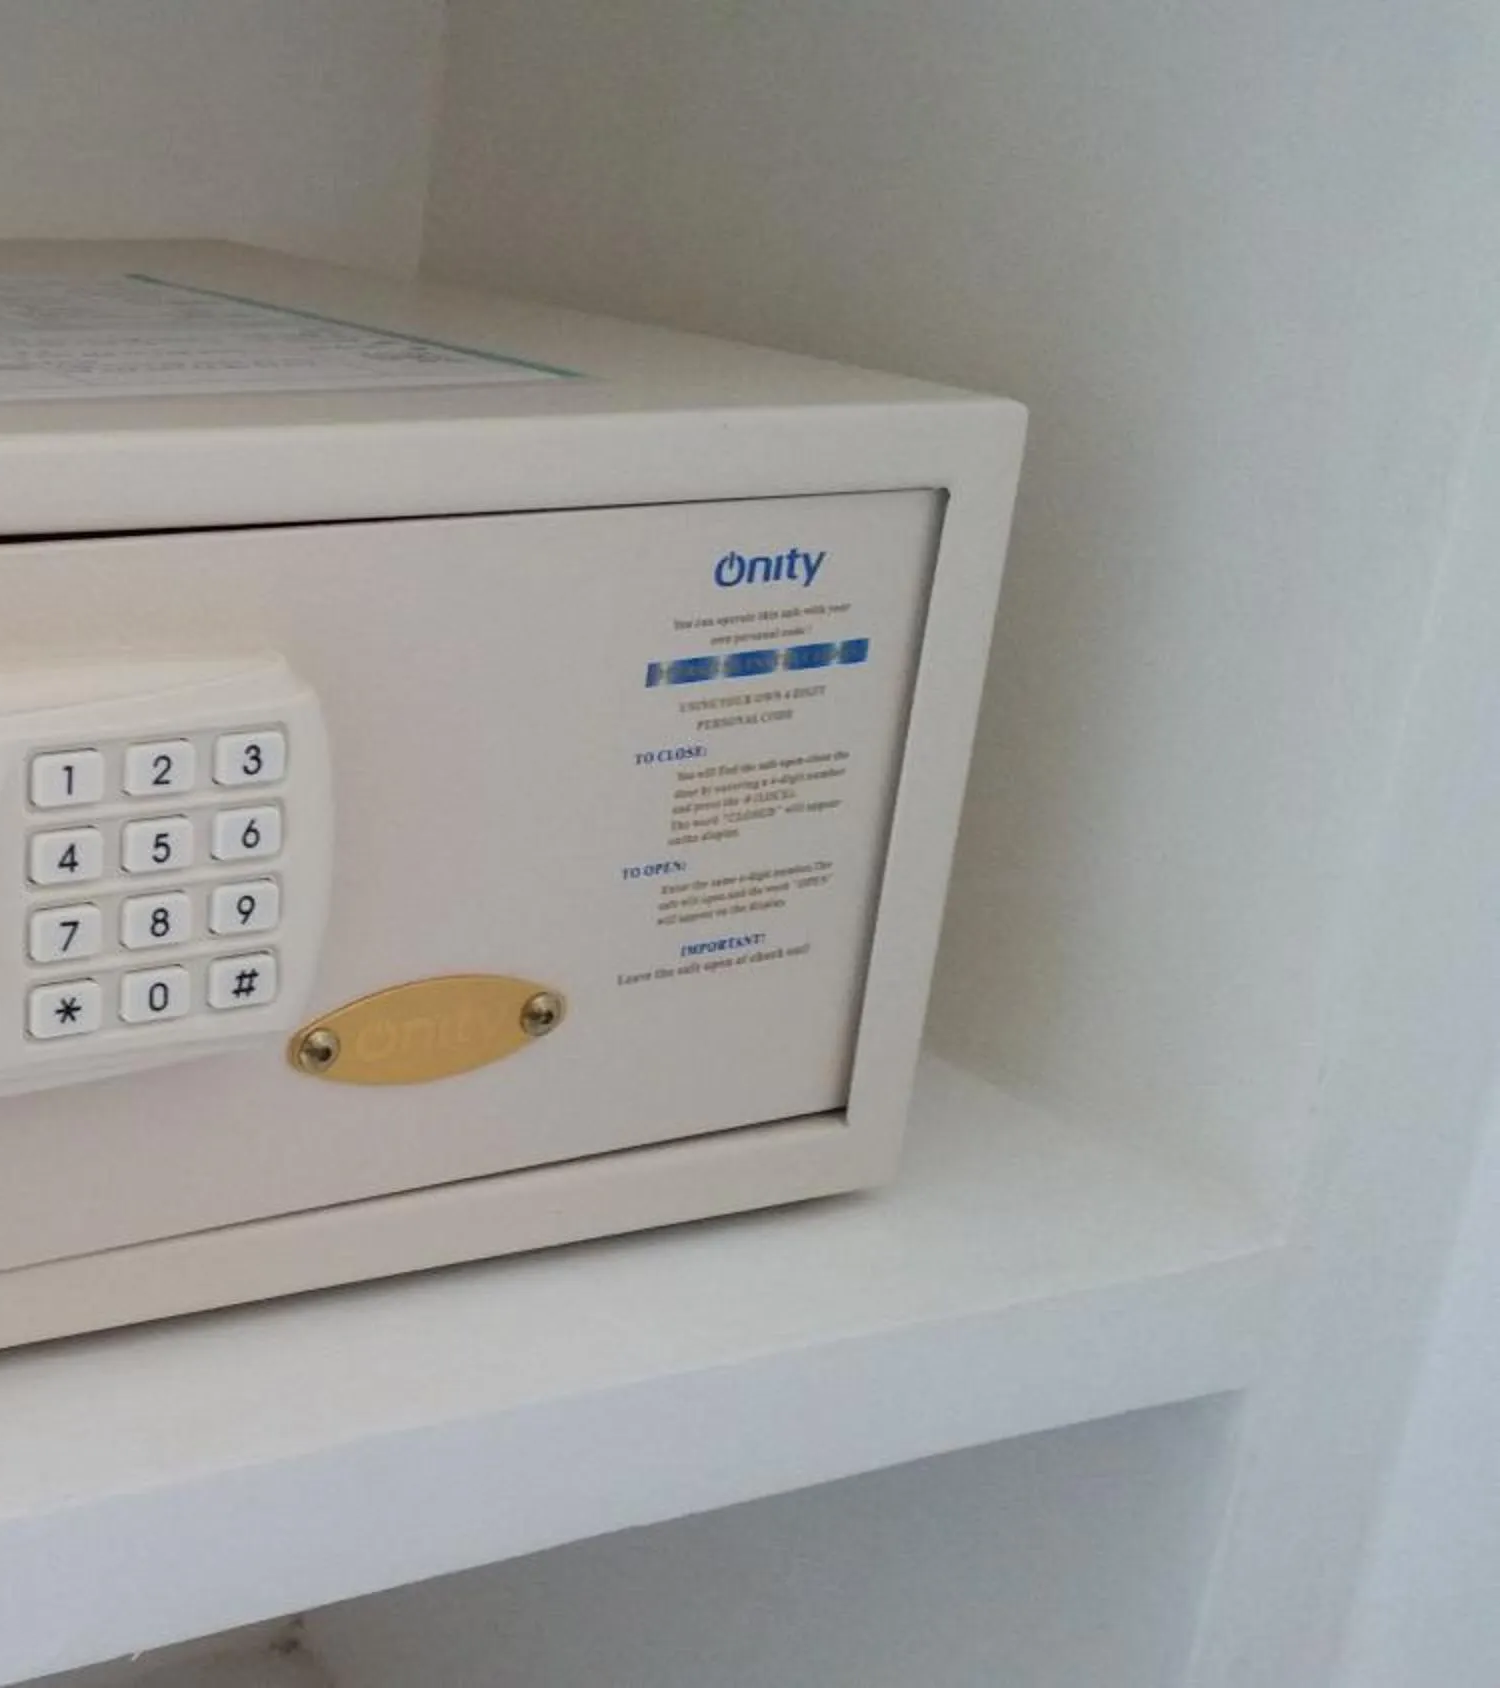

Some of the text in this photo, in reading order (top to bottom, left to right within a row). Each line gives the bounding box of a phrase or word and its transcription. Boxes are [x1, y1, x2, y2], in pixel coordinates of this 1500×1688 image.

[713, 545, 827, 588] Onity
[696, 708, 794, 732] PERSONAL CODE
[61, 744, 263, 795] 1 2 3
[634, 745, 708, 766] TO CLOSE:
[58, 820, 261, 873] 4 5 6
[621, 865, 641, 881] TO
[59, 895, 256, 951] 7 8 9
[148, 981, 169, 1012] 0
[231, 968, 260, 998] #
[616, 971, 652, 987] Leave
[653, 966, 674, 980] the
[703, 957, 734, 972] open
